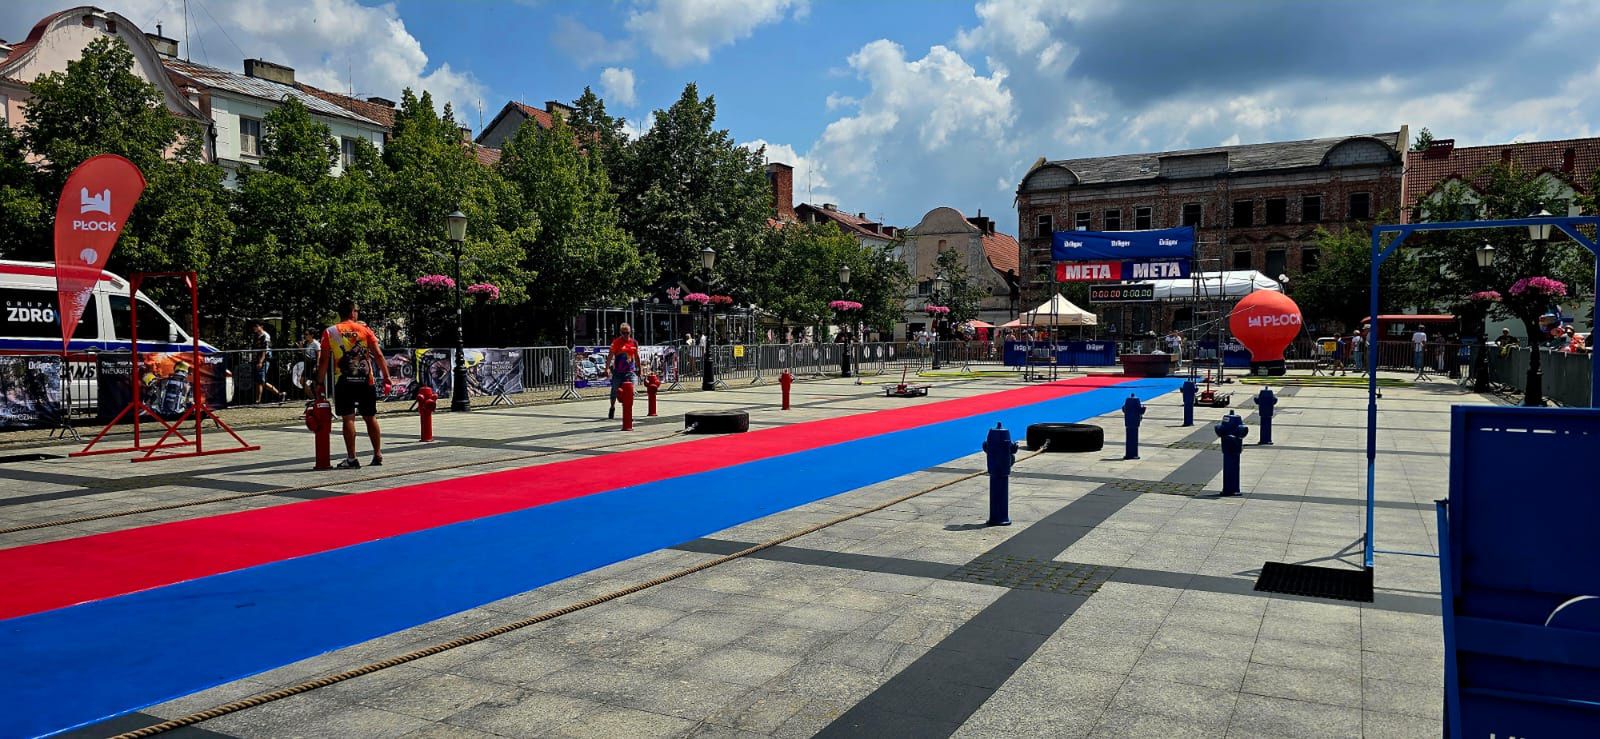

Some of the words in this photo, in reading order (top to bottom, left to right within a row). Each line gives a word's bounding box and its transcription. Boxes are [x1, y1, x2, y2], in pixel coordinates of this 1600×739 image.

[73, 220, 117, 231] PŁOCK
[1159, 238, 1178, 246] Dräger
[1065, 264, 1112, 280] META
[1132, 262, 1181, 278] META
